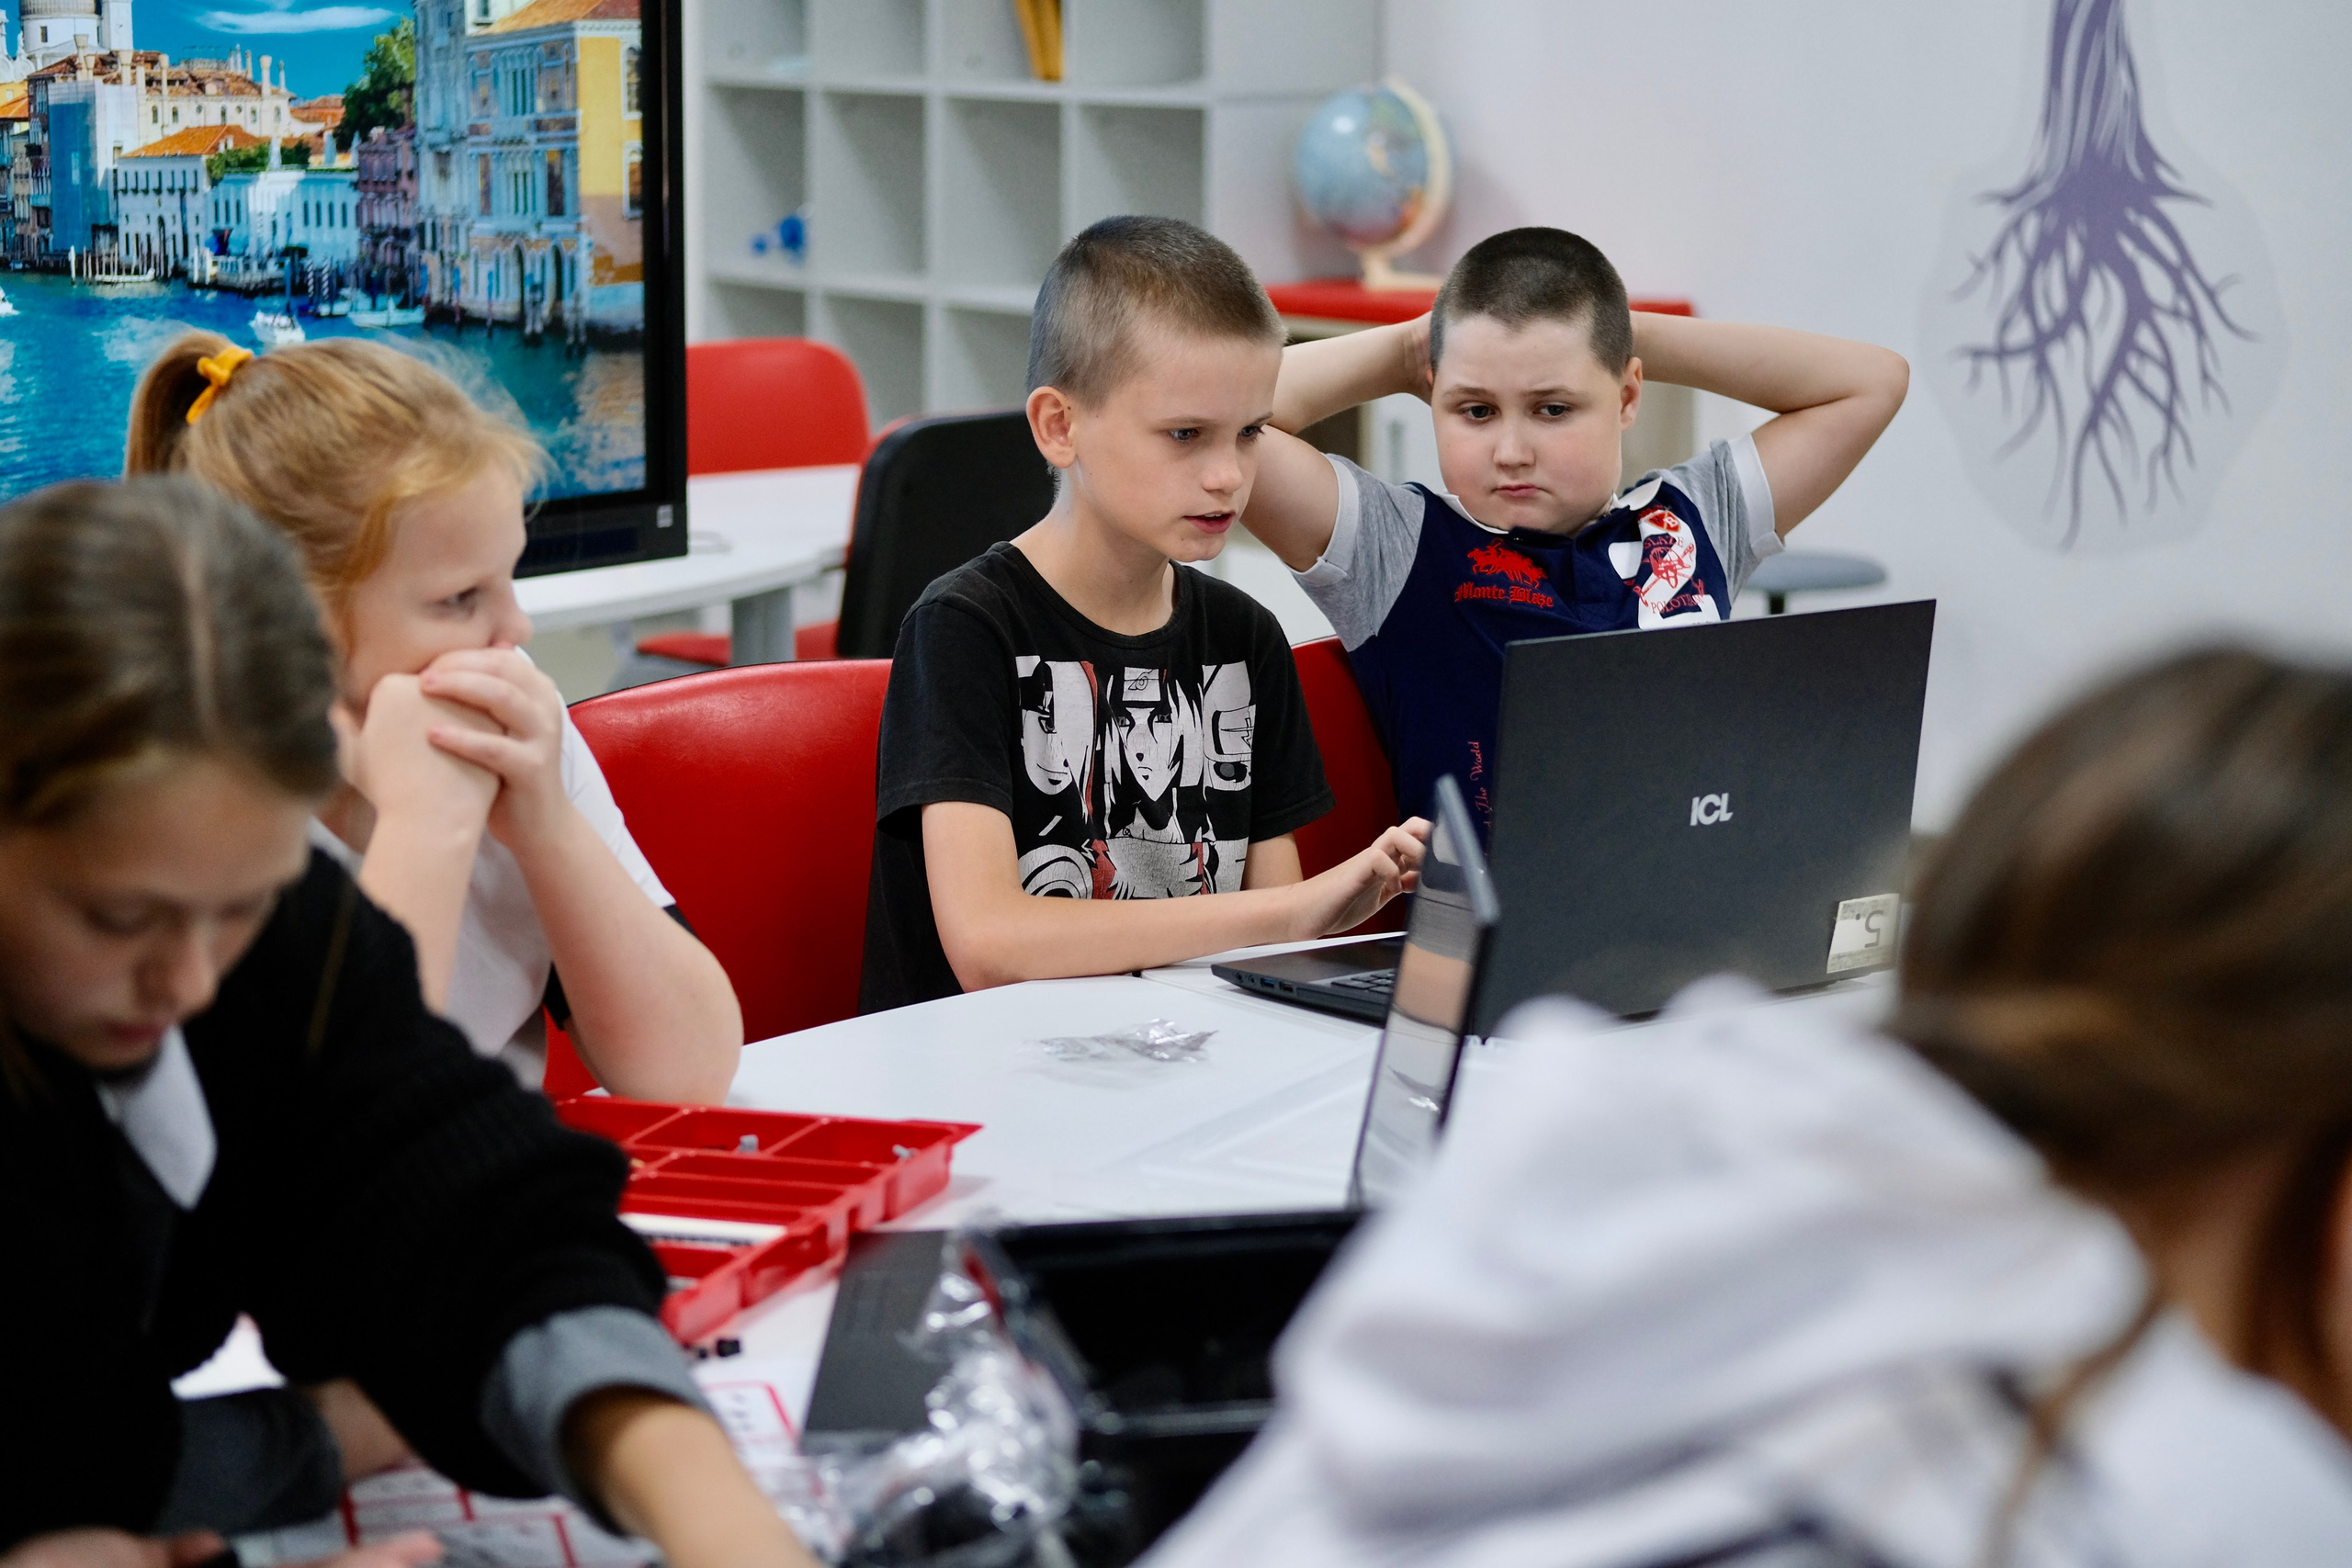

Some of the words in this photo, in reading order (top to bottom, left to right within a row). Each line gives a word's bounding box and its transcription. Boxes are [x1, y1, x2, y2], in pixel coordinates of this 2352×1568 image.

[1454, 581, 1506, 603] Monte
[1509, 585, 1554, 608] Blaze
[1690, 792, 1734, 827] ICL
